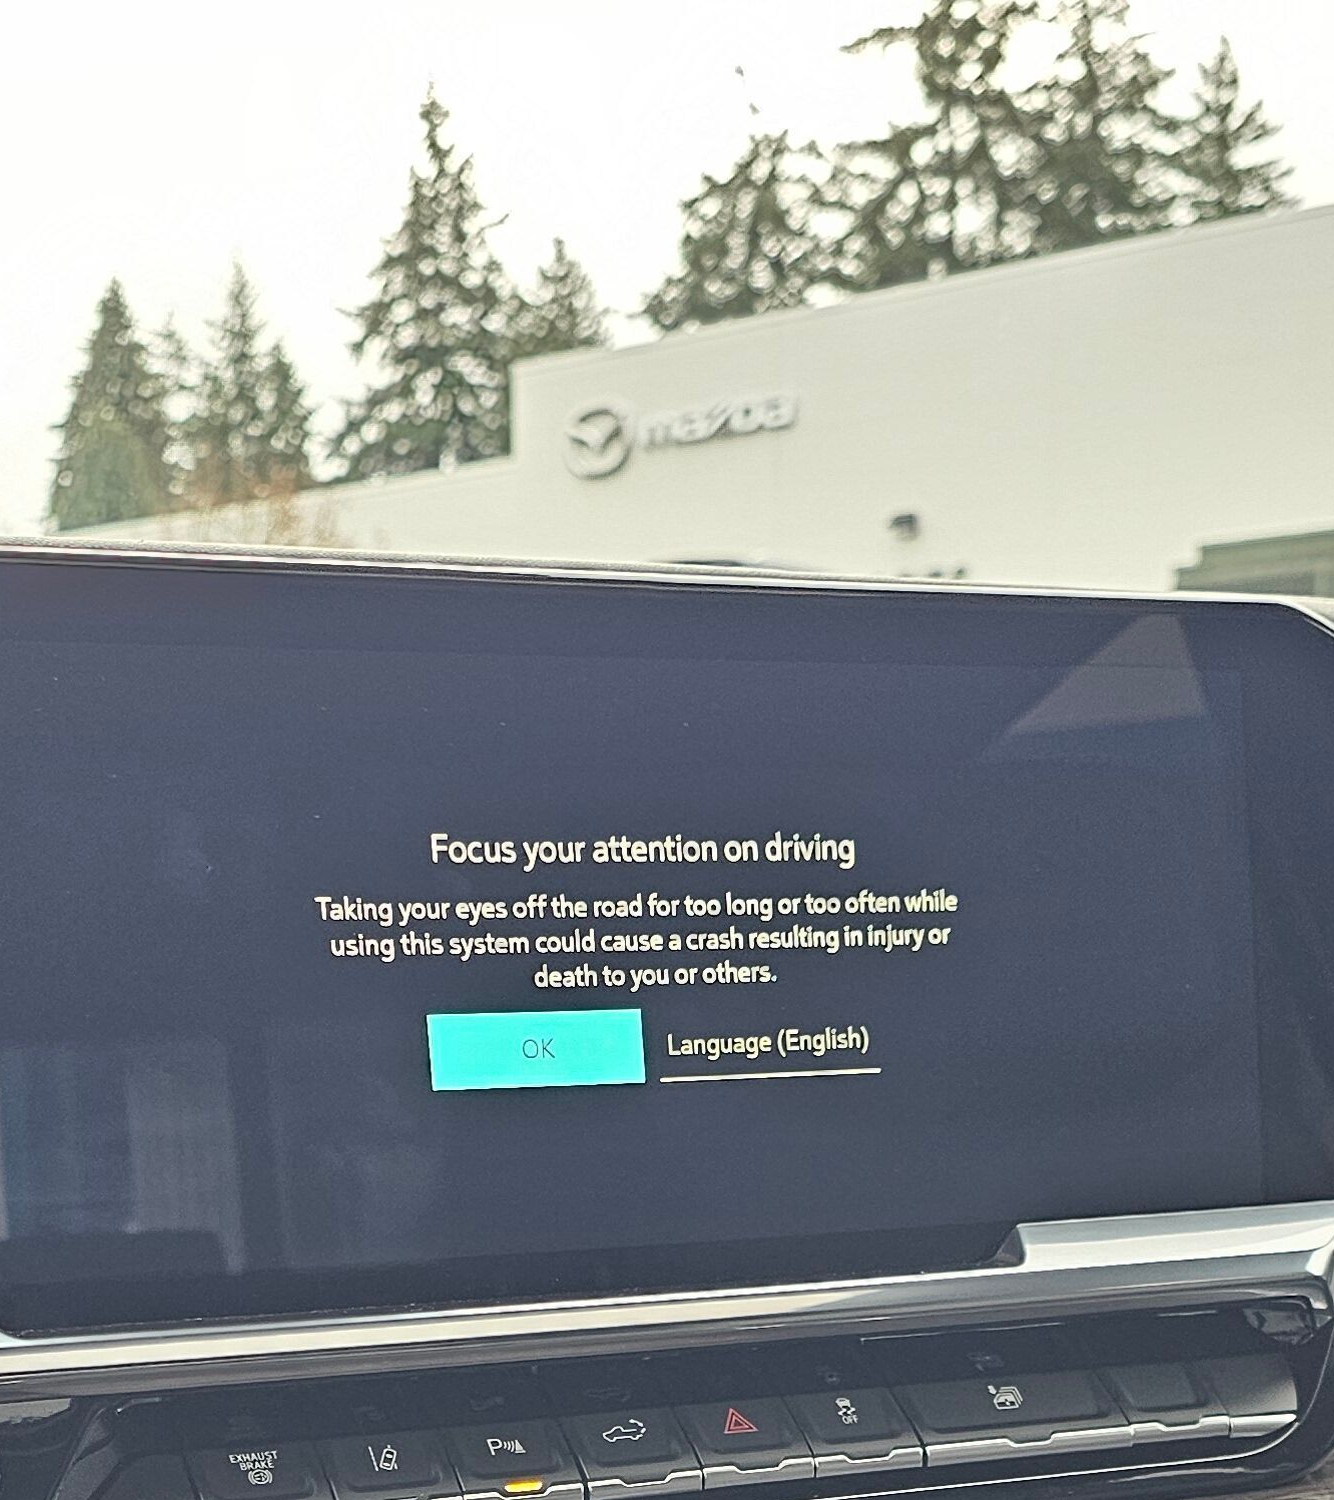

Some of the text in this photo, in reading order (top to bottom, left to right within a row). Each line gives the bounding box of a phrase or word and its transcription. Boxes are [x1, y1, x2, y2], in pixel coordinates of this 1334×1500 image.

[430, 831, 855, 872] Focus your attention on driving
[314, 888, 959, 927] Taking your eyes off the road for too long or too often while
[330, 924, 951, 963] using this system could cause a crash resulting in injury or
[534, 959, 777, 993] death to you or others.
[522, 1038, 556, 1059] OK
[667, 1025, 870, 1061] Language (English)
[228, 1450, 278, 1464] EXHAUST
[239, 1460, 275, 1471] BRAKE
